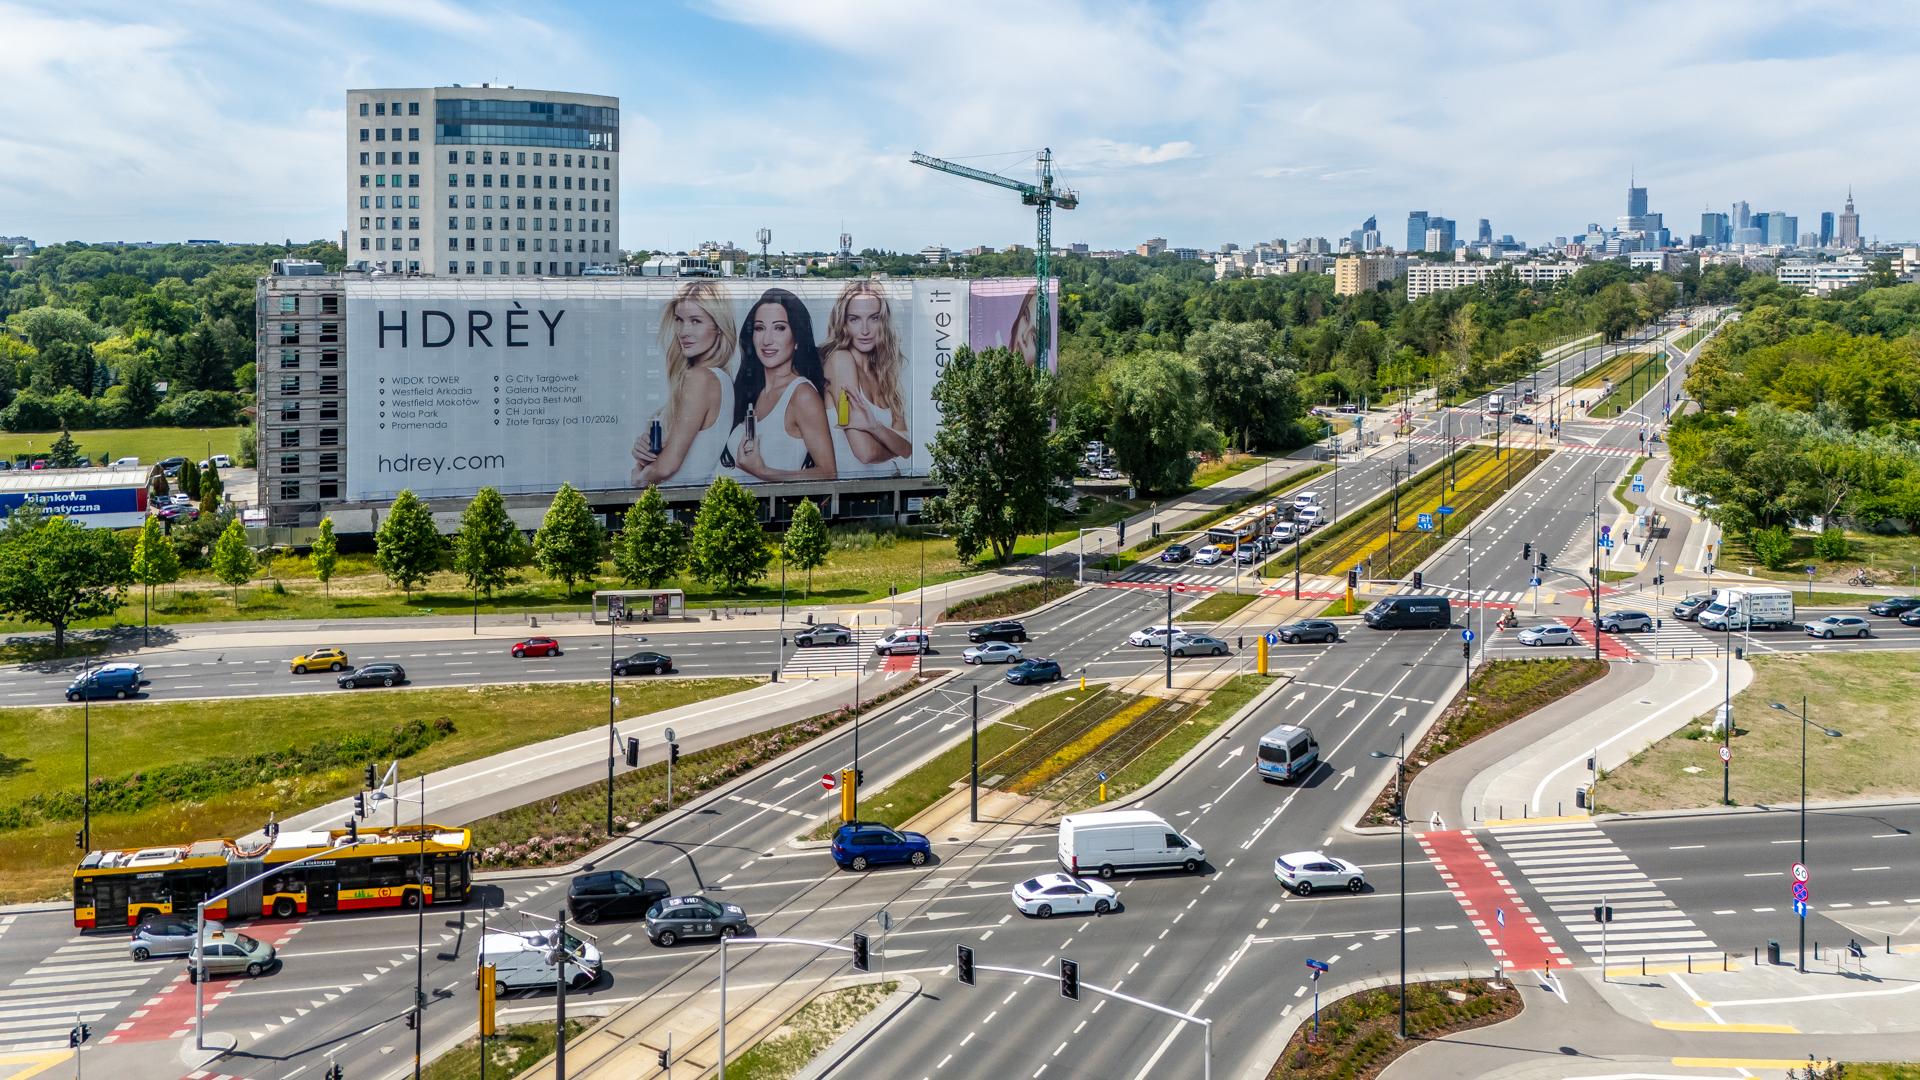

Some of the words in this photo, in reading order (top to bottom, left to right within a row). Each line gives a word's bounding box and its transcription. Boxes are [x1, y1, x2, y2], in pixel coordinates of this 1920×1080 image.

[930, 289, 951, 303] it
[379, 301, 565, 348] HDRÈY
[391, 376, 424, 386] WIDOK
[427, 376, 460, 385] TOWER
[505, 375, 515, 384] G
[516, 375, 534, 385] City
[535, 373, 580, 384] Targówek
[392, 387, 434, 396] Westfield
[437, 386, 472, 395] Arkadia
[505, 386, 540, 395] Galeria
[541, 385, 577, 394] Młociny
[392, 398, 434, 408] Westfield
[437, 397, 480, 407] Mokotów
[505, 397, 541, 406] Sadyba
[543, 396, 561, 404] Best
[563, 395, 582, 404] Mall
[392, 410, 416, 418] Wola
[418, 410, 439, 418] Park
[505, 407, 520, 416] CH
[522, 407, 545, 416] Janki
[391, 420, 448, 430] Promenada
[532, 417, 560, 426] Tarasy
[562, 415, 579, 426] (od
[581, 415, 619, 425] 10/2026)
[379, 454, 504, 475] hdrey.com
[1795, 867, 1806, 878] 60
